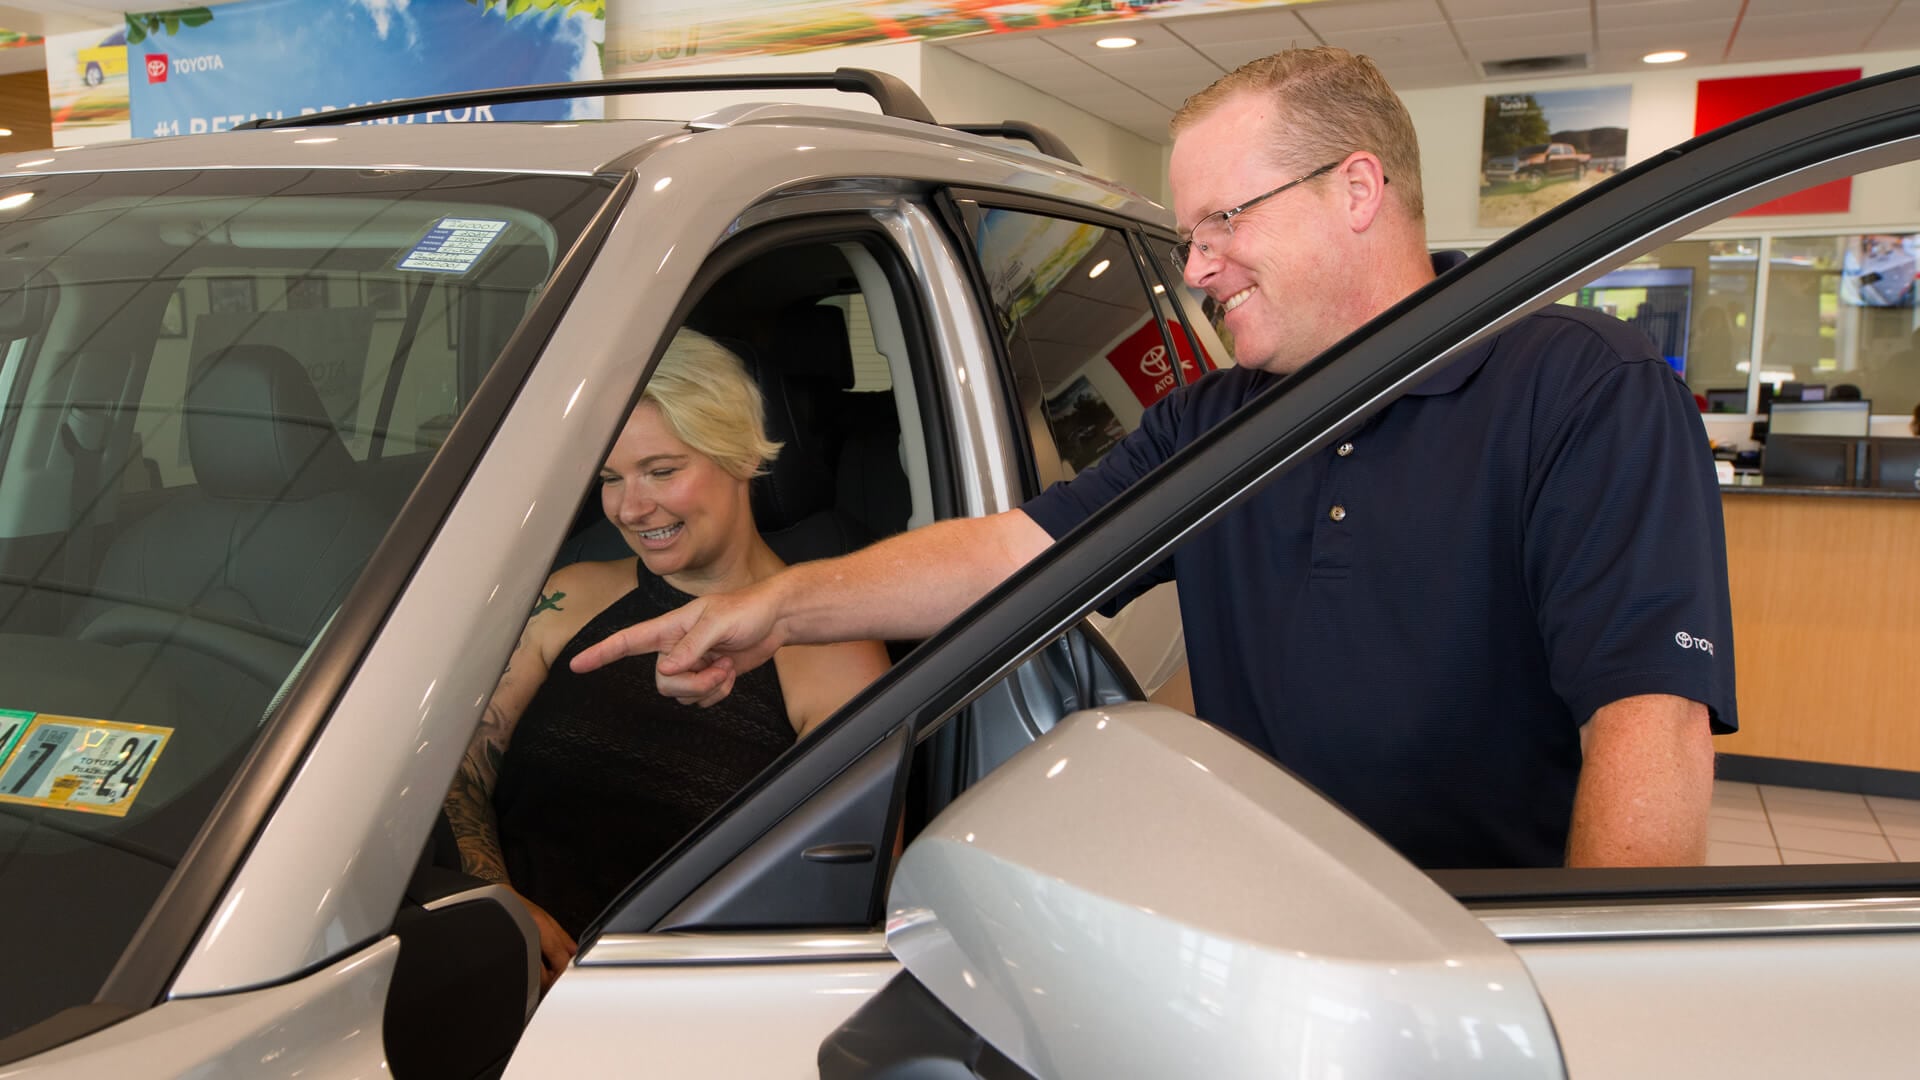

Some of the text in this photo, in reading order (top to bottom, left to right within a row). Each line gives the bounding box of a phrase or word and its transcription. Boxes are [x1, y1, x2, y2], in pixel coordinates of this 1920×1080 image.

[172, 54, 224, 75] TOYOTA
[190, 110, 283, 135] RET
[9, 742, 58, 794] 7
[95, 737, 159, 798] 24
